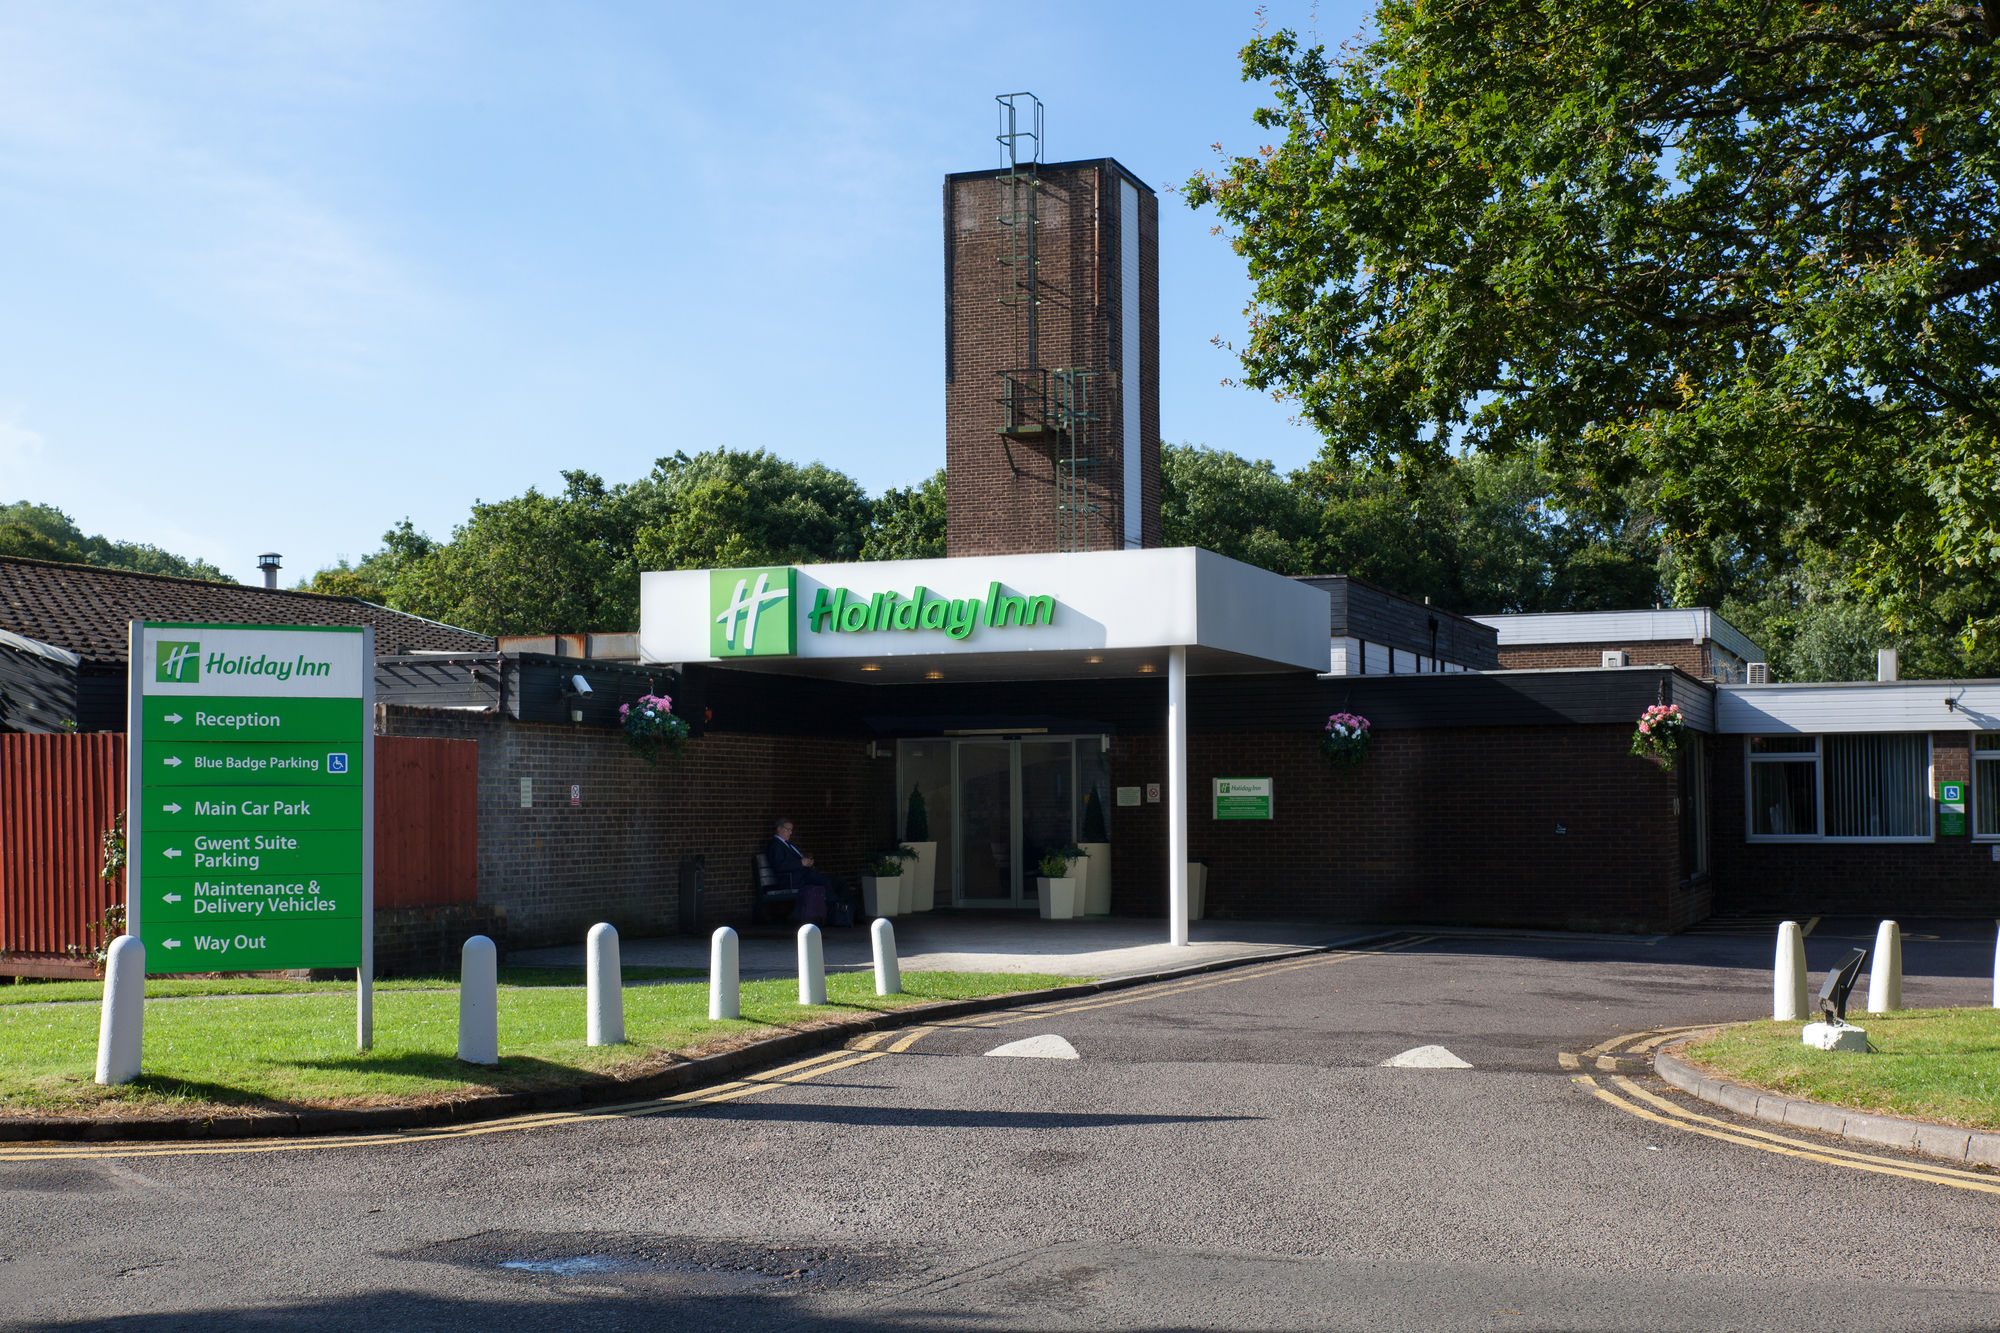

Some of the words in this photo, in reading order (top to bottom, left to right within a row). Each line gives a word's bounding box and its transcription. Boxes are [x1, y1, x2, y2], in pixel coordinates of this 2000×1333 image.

[808, 586, 980, 640] Holiday
[984, 581, 1055, 627] Inn
[206, 653, 293, 680] Holiday
[296, 655, 330, 676] Inn
[195, 712, 280, 729] Reception
[194, 756, 222, 768] Blue
[226, 757, 267, 771] Badge
[270, 757, 319, 771] Parking
[194, 801, 236, 815] Main
[241, 801, 269, 815] Car
[274, 800, 311, 815] Park
[194, 836, 250, 850] Gwent
[254, 835, 297, 850] Suite
[194, 853, 260, 871] Parking
[194, 881, 304, 896] Maintenance
[308, 880, 321, 895] &
[194, 898, 265, 916] Delivery
[268, 896, 336, 912] Vehicles
[194, 936, 230, 954] Way
[234, 935, 266, 949] Out
